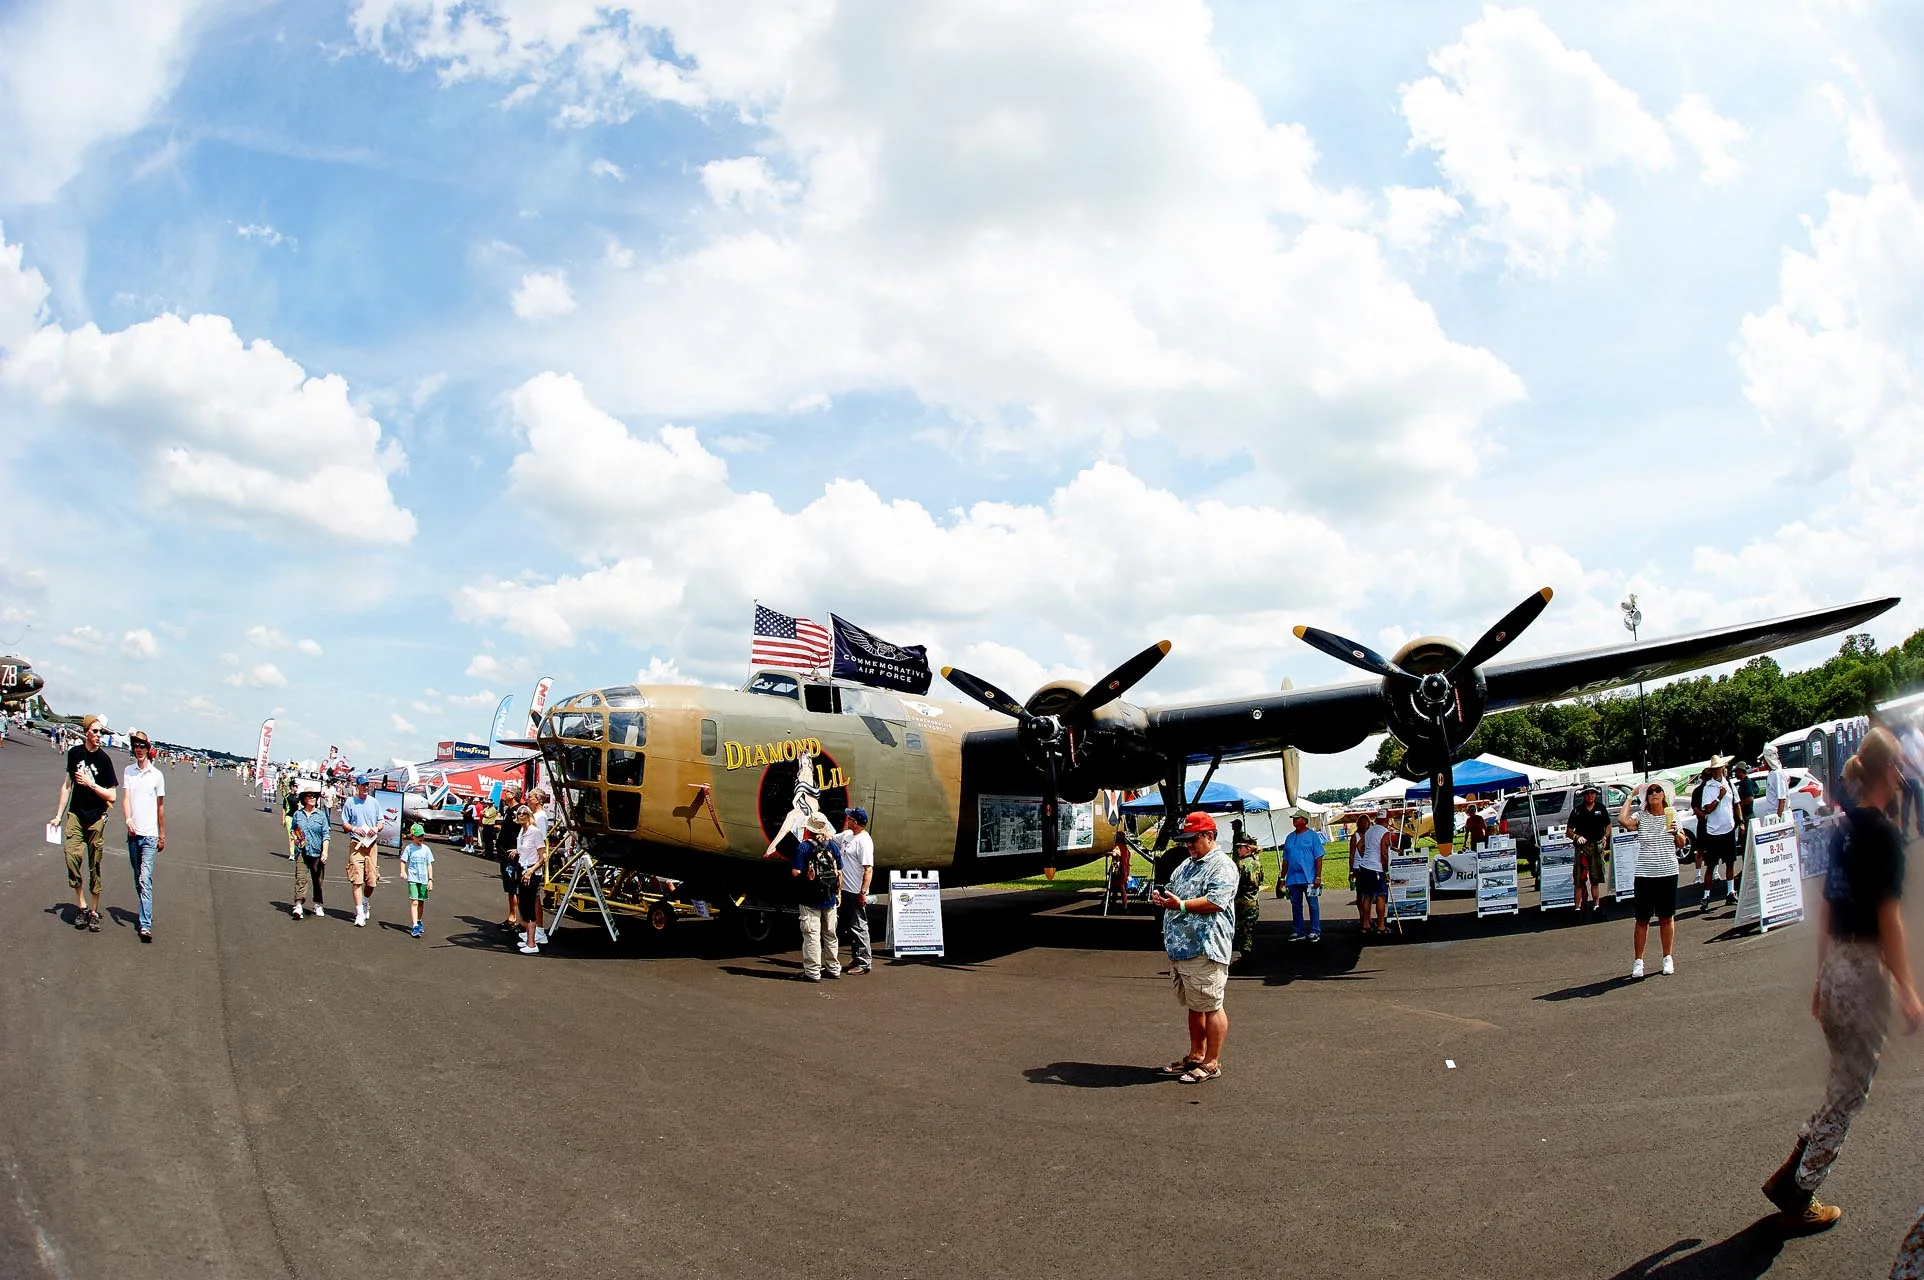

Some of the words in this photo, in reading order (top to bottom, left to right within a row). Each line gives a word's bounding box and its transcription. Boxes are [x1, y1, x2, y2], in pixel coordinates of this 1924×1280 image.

[843, 654, 925, 678] COMMEMORATIVE
[858, 666, 875, 675] AIR
[879, 670, 912, 683] FORCE
[528, 683, 549, 738] WLEN
[258, 726, 273, 779] WHELEN
[455, 745, 490, 756] GOODYEAR
[1769, 842, 1784, 854] B-24
[1762, 854, 1781, 865] Aircraft
[1780, 852, 1793, 862] Tours
[1769, 878, 1780, 888] Start
[1780, 877, 1791, 886] Here
